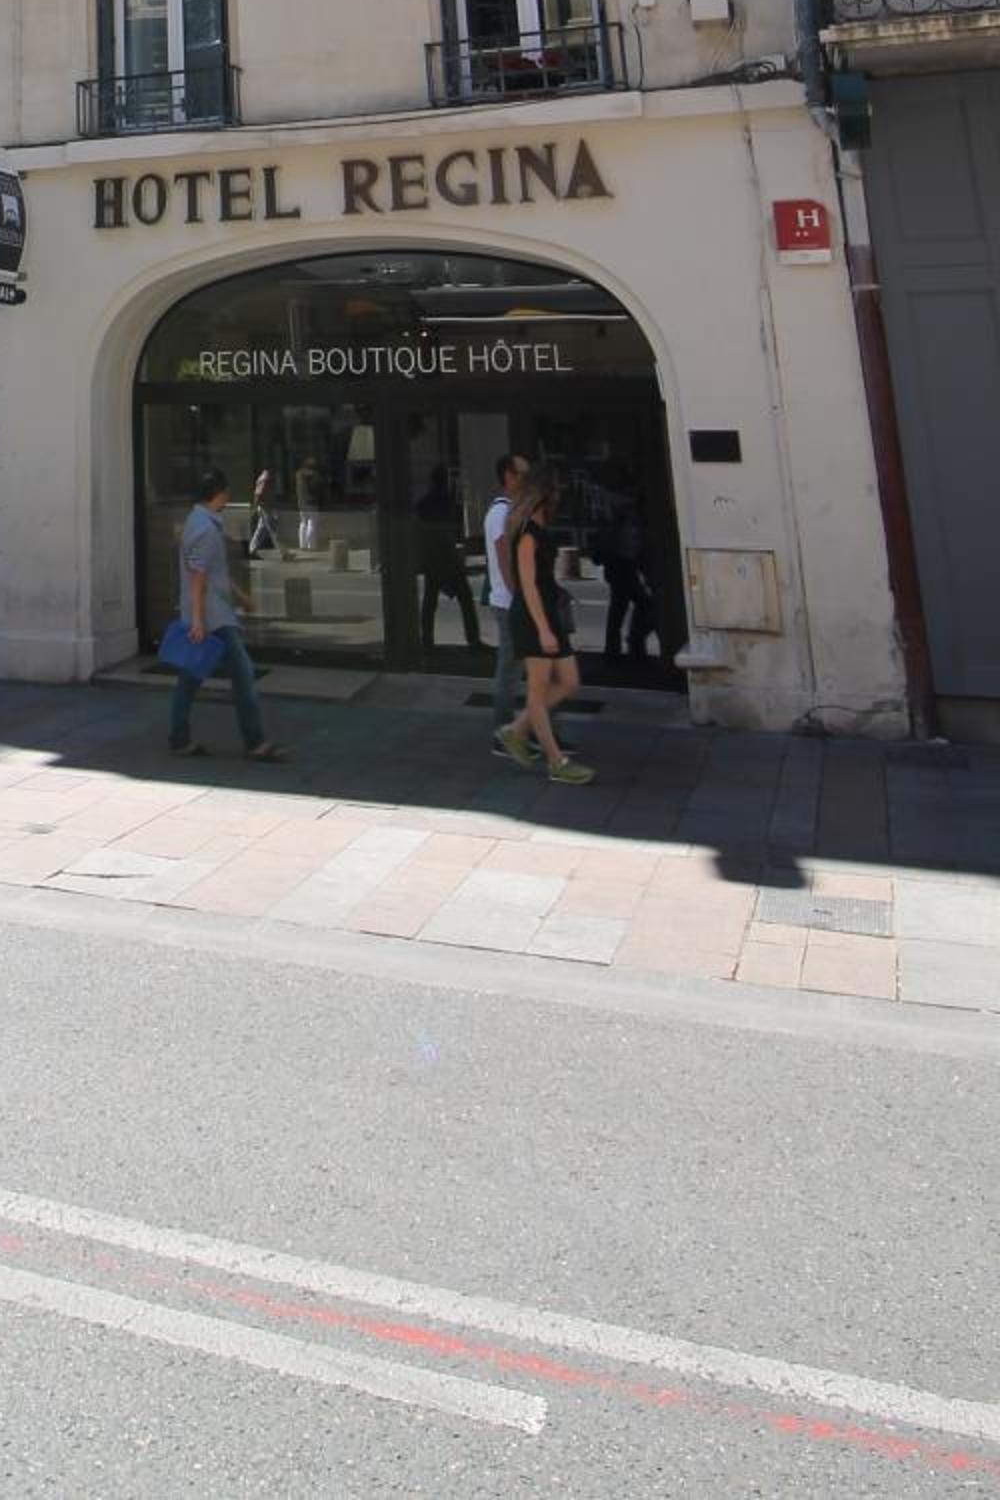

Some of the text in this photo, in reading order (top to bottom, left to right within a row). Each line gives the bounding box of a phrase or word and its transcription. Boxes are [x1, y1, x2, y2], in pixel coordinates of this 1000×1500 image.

[94, 139, 614, 229] HOTEL REGINA
[797, 209, 820, 228] H
[200, 339, 574, 379] REGINA BOUTIQUE HÔTEL
